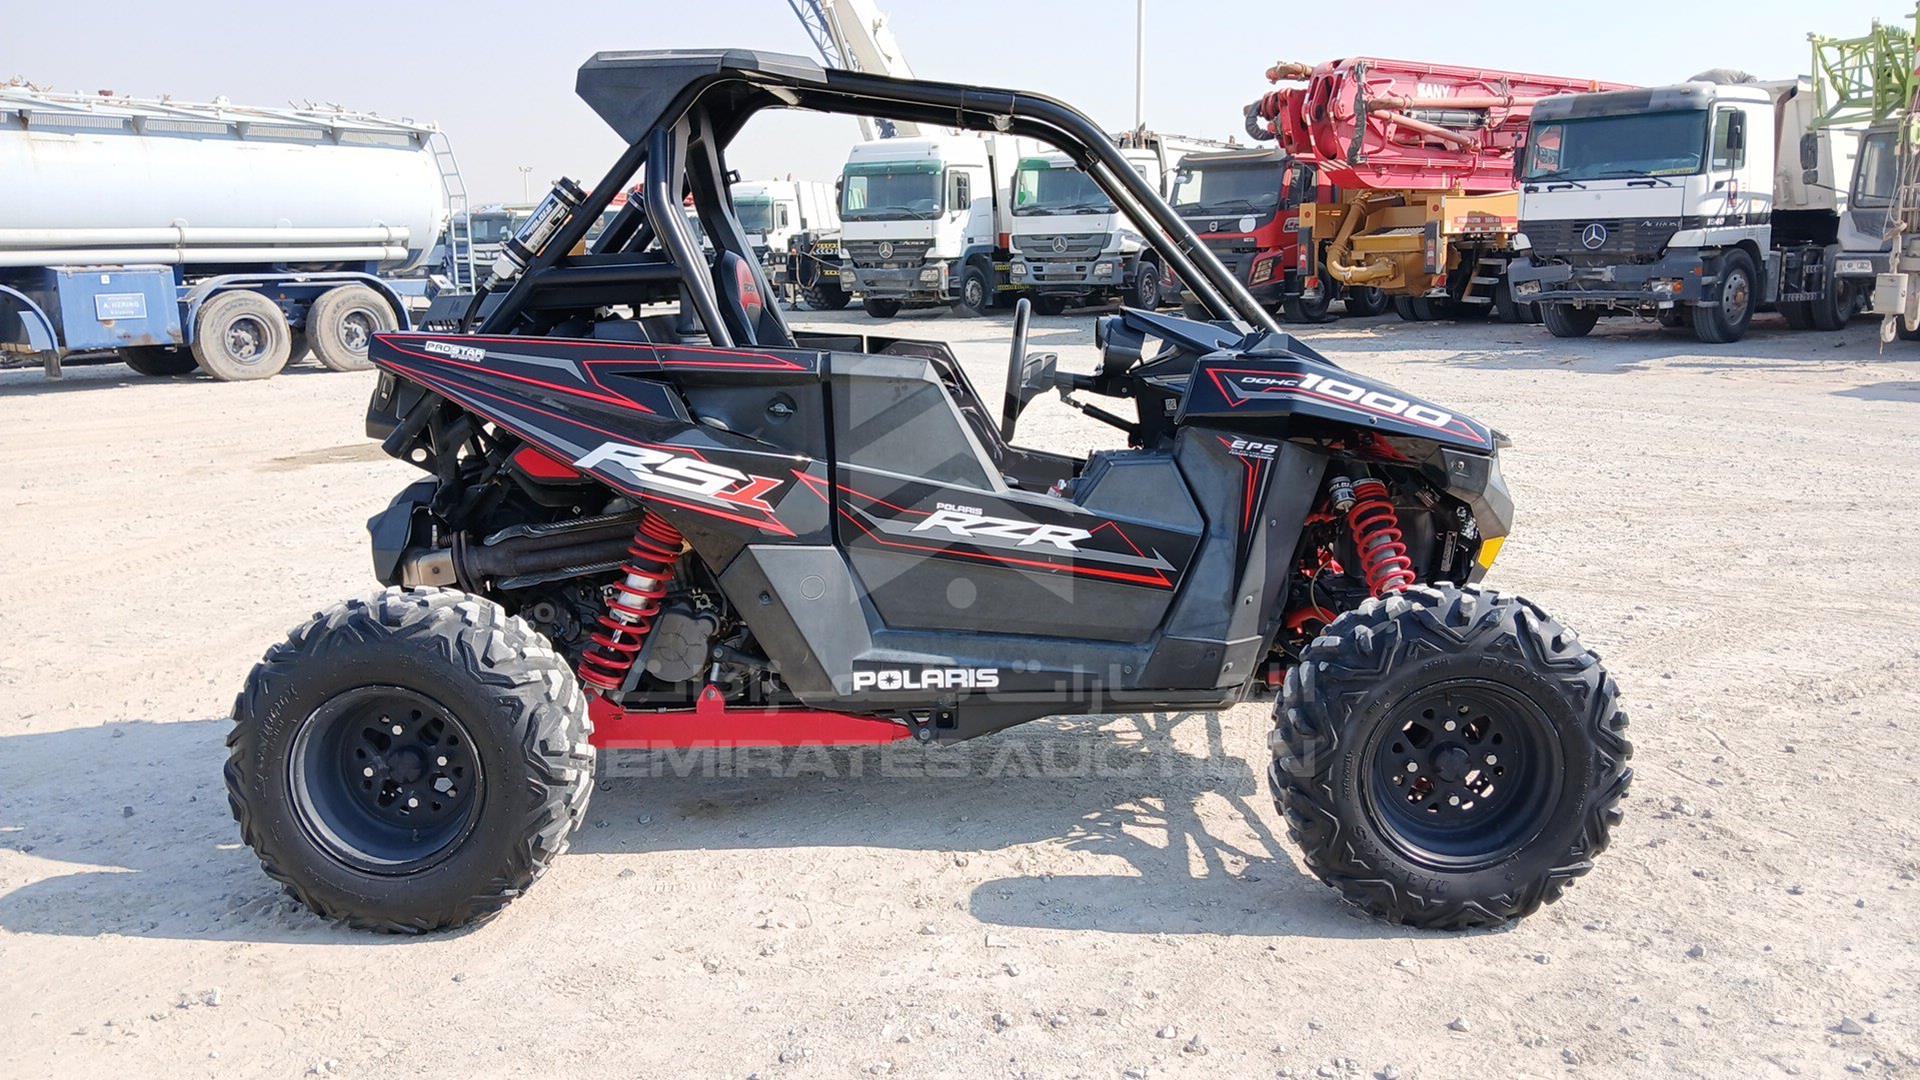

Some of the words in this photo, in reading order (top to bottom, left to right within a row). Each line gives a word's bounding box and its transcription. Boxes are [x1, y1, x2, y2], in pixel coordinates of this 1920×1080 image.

[1417, 82, 1450, 99] SANY
[425, 341, 486, 359] PROSTAR
[1241, 376, 1300, 387] DOHC
[1298, 372, 1453, 428] 1000
[1230, 439, 1279, 454] EPS
[573, 441, 785, 513] RS1
[936, 502, 983, 515] POLARIS
[911, 509, 1093, 552] RZR
[853, 668, 1000, 691] POLARIS
